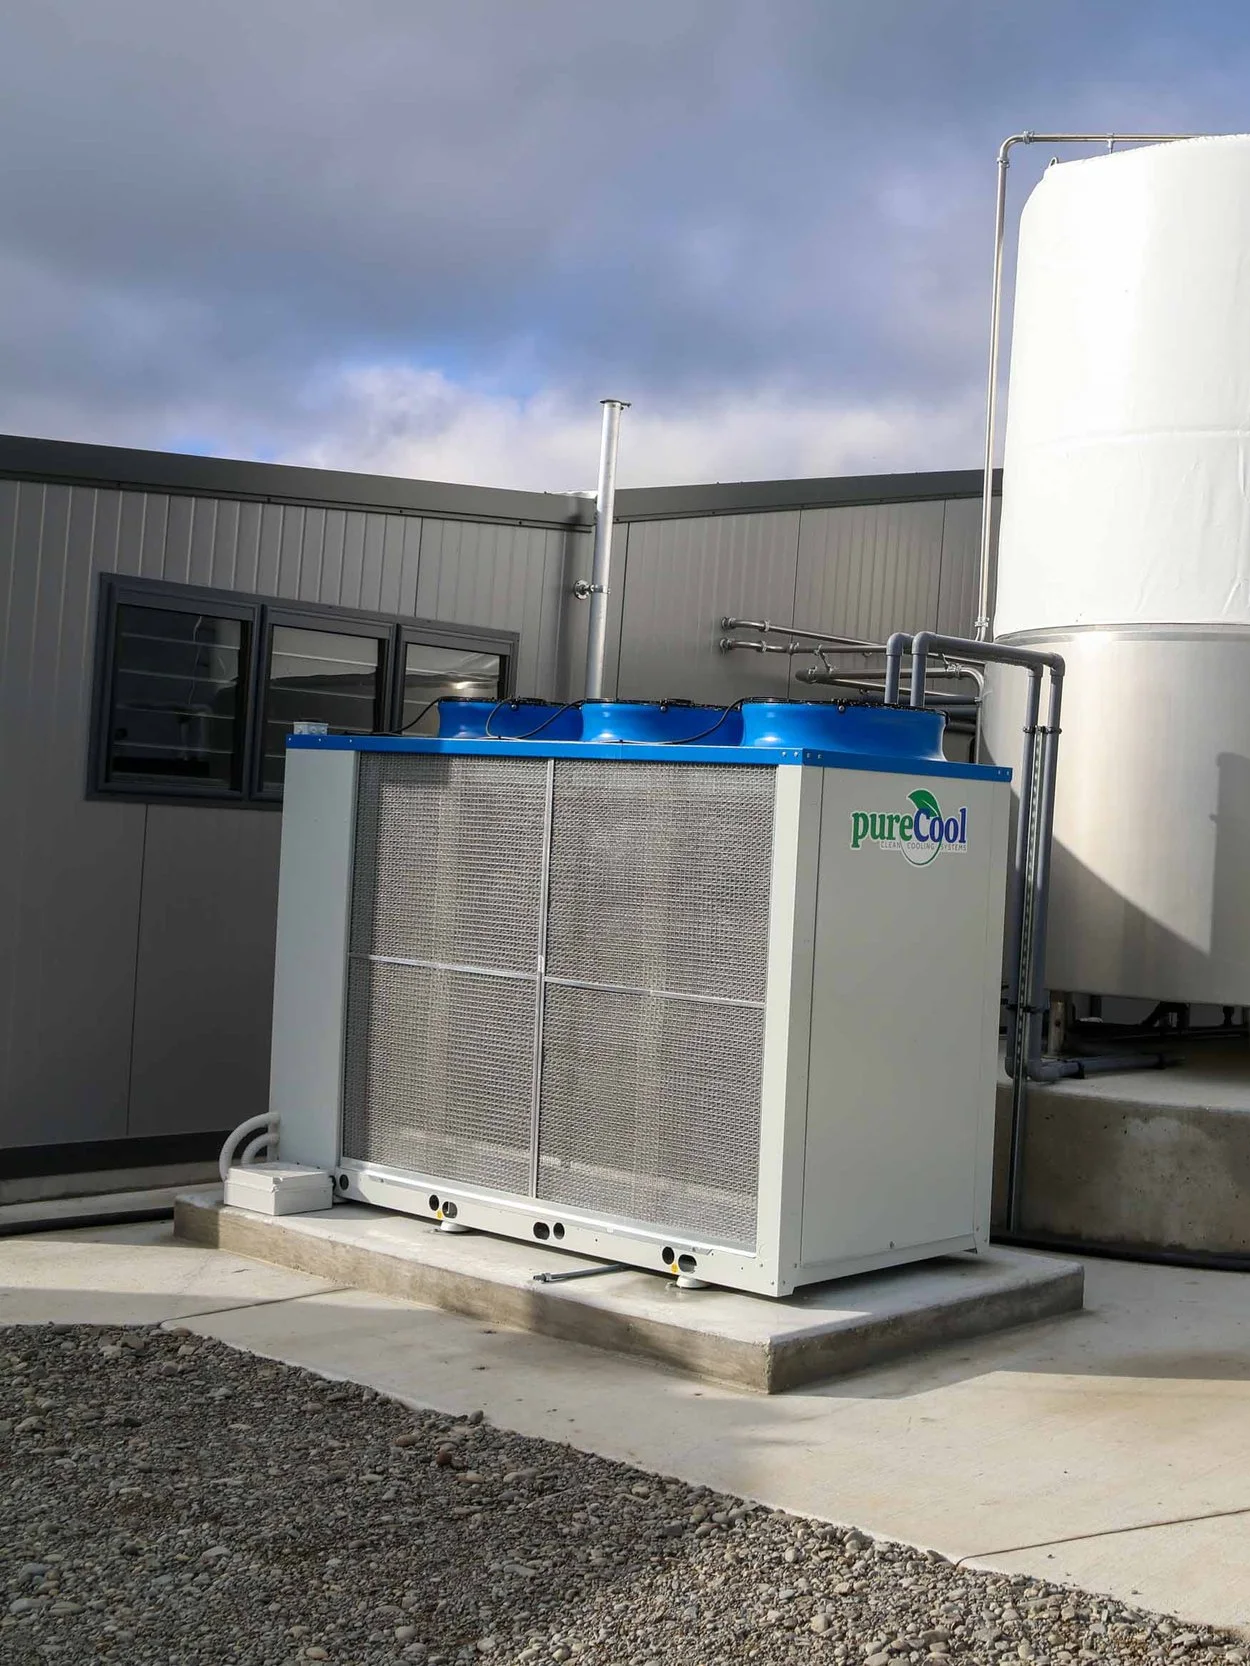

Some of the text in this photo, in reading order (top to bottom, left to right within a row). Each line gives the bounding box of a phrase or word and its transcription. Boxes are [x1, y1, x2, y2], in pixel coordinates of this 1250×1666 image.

[851, 807, 967, 848] pureCool
[881, 841, 967, 851] CLEAN COOLING SYSTEMS
